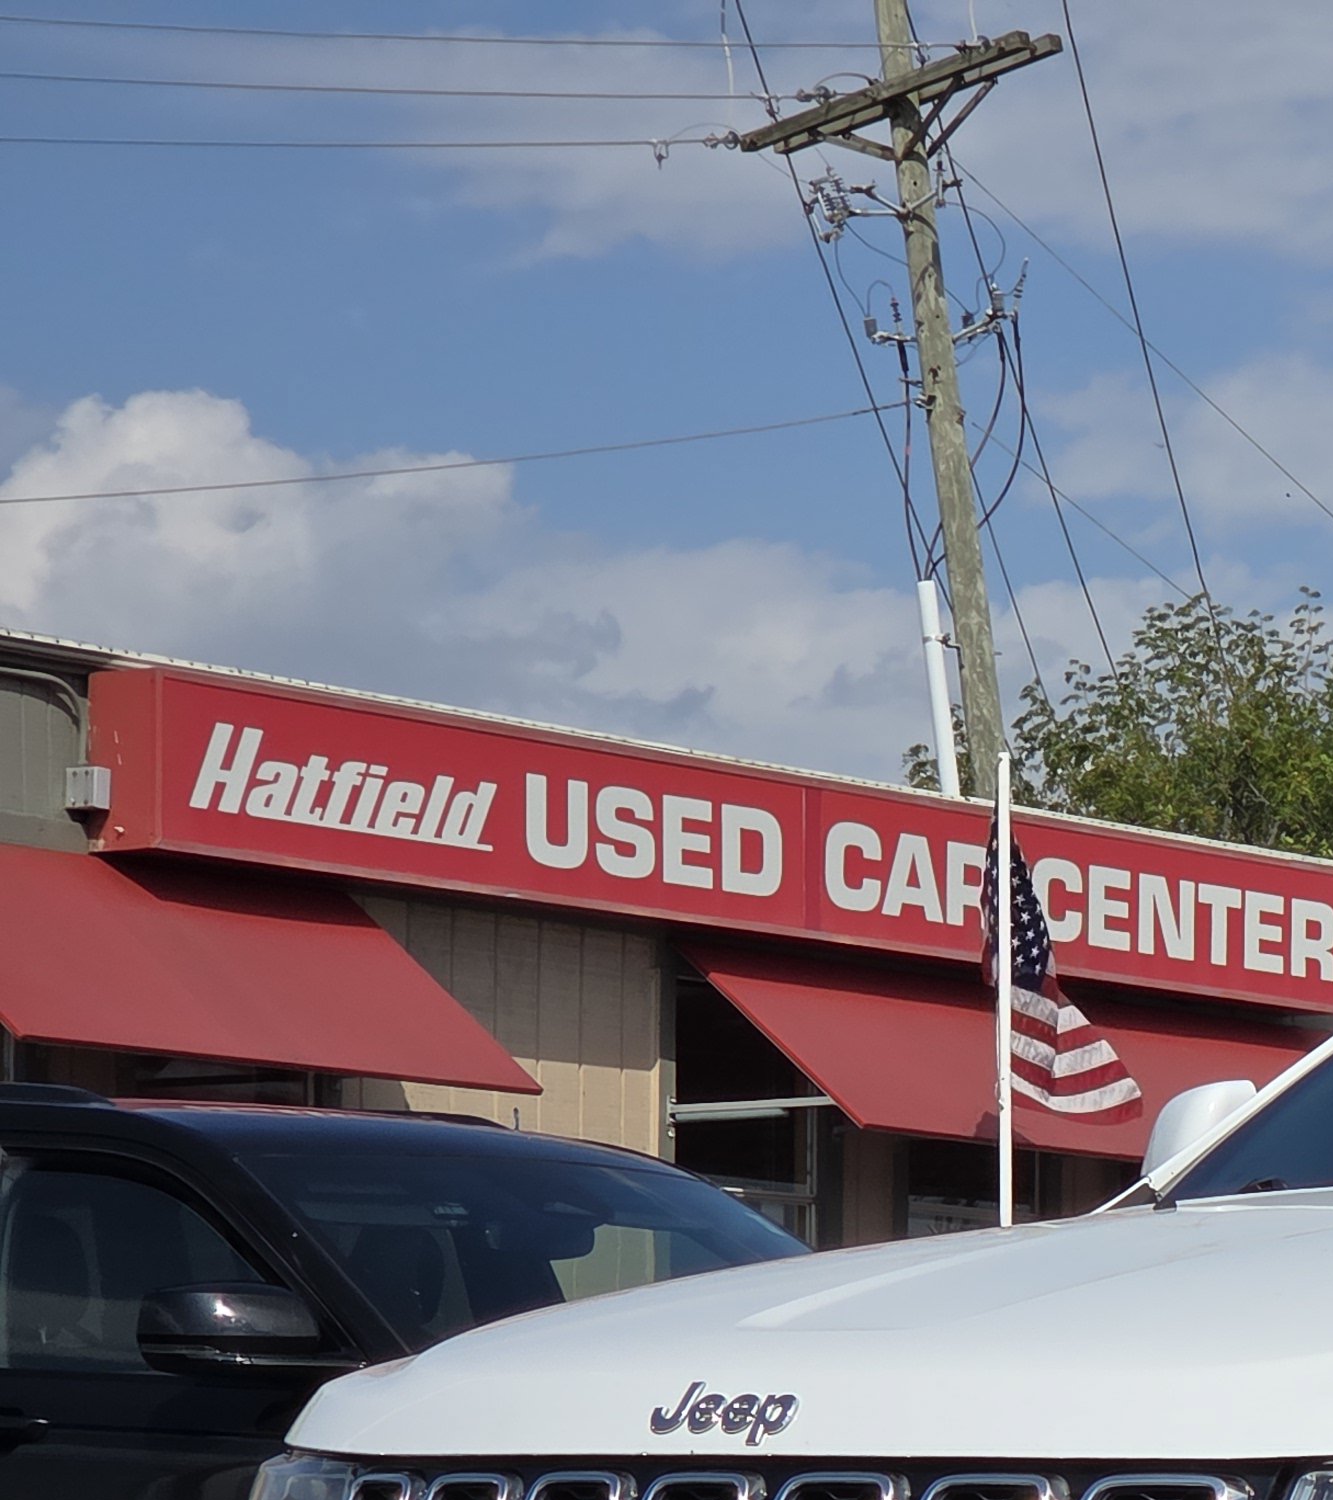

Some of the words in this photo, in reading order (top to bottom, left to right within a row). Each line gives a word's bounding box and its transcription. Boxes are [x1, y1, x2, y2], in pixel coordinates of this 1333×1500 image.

[189, 722, 497, 852] Hatfield
[525, 772, 783, 897] USED
[825, 821, 987, 930] CAR
[650, 1381, 799, 1446] Jeep
